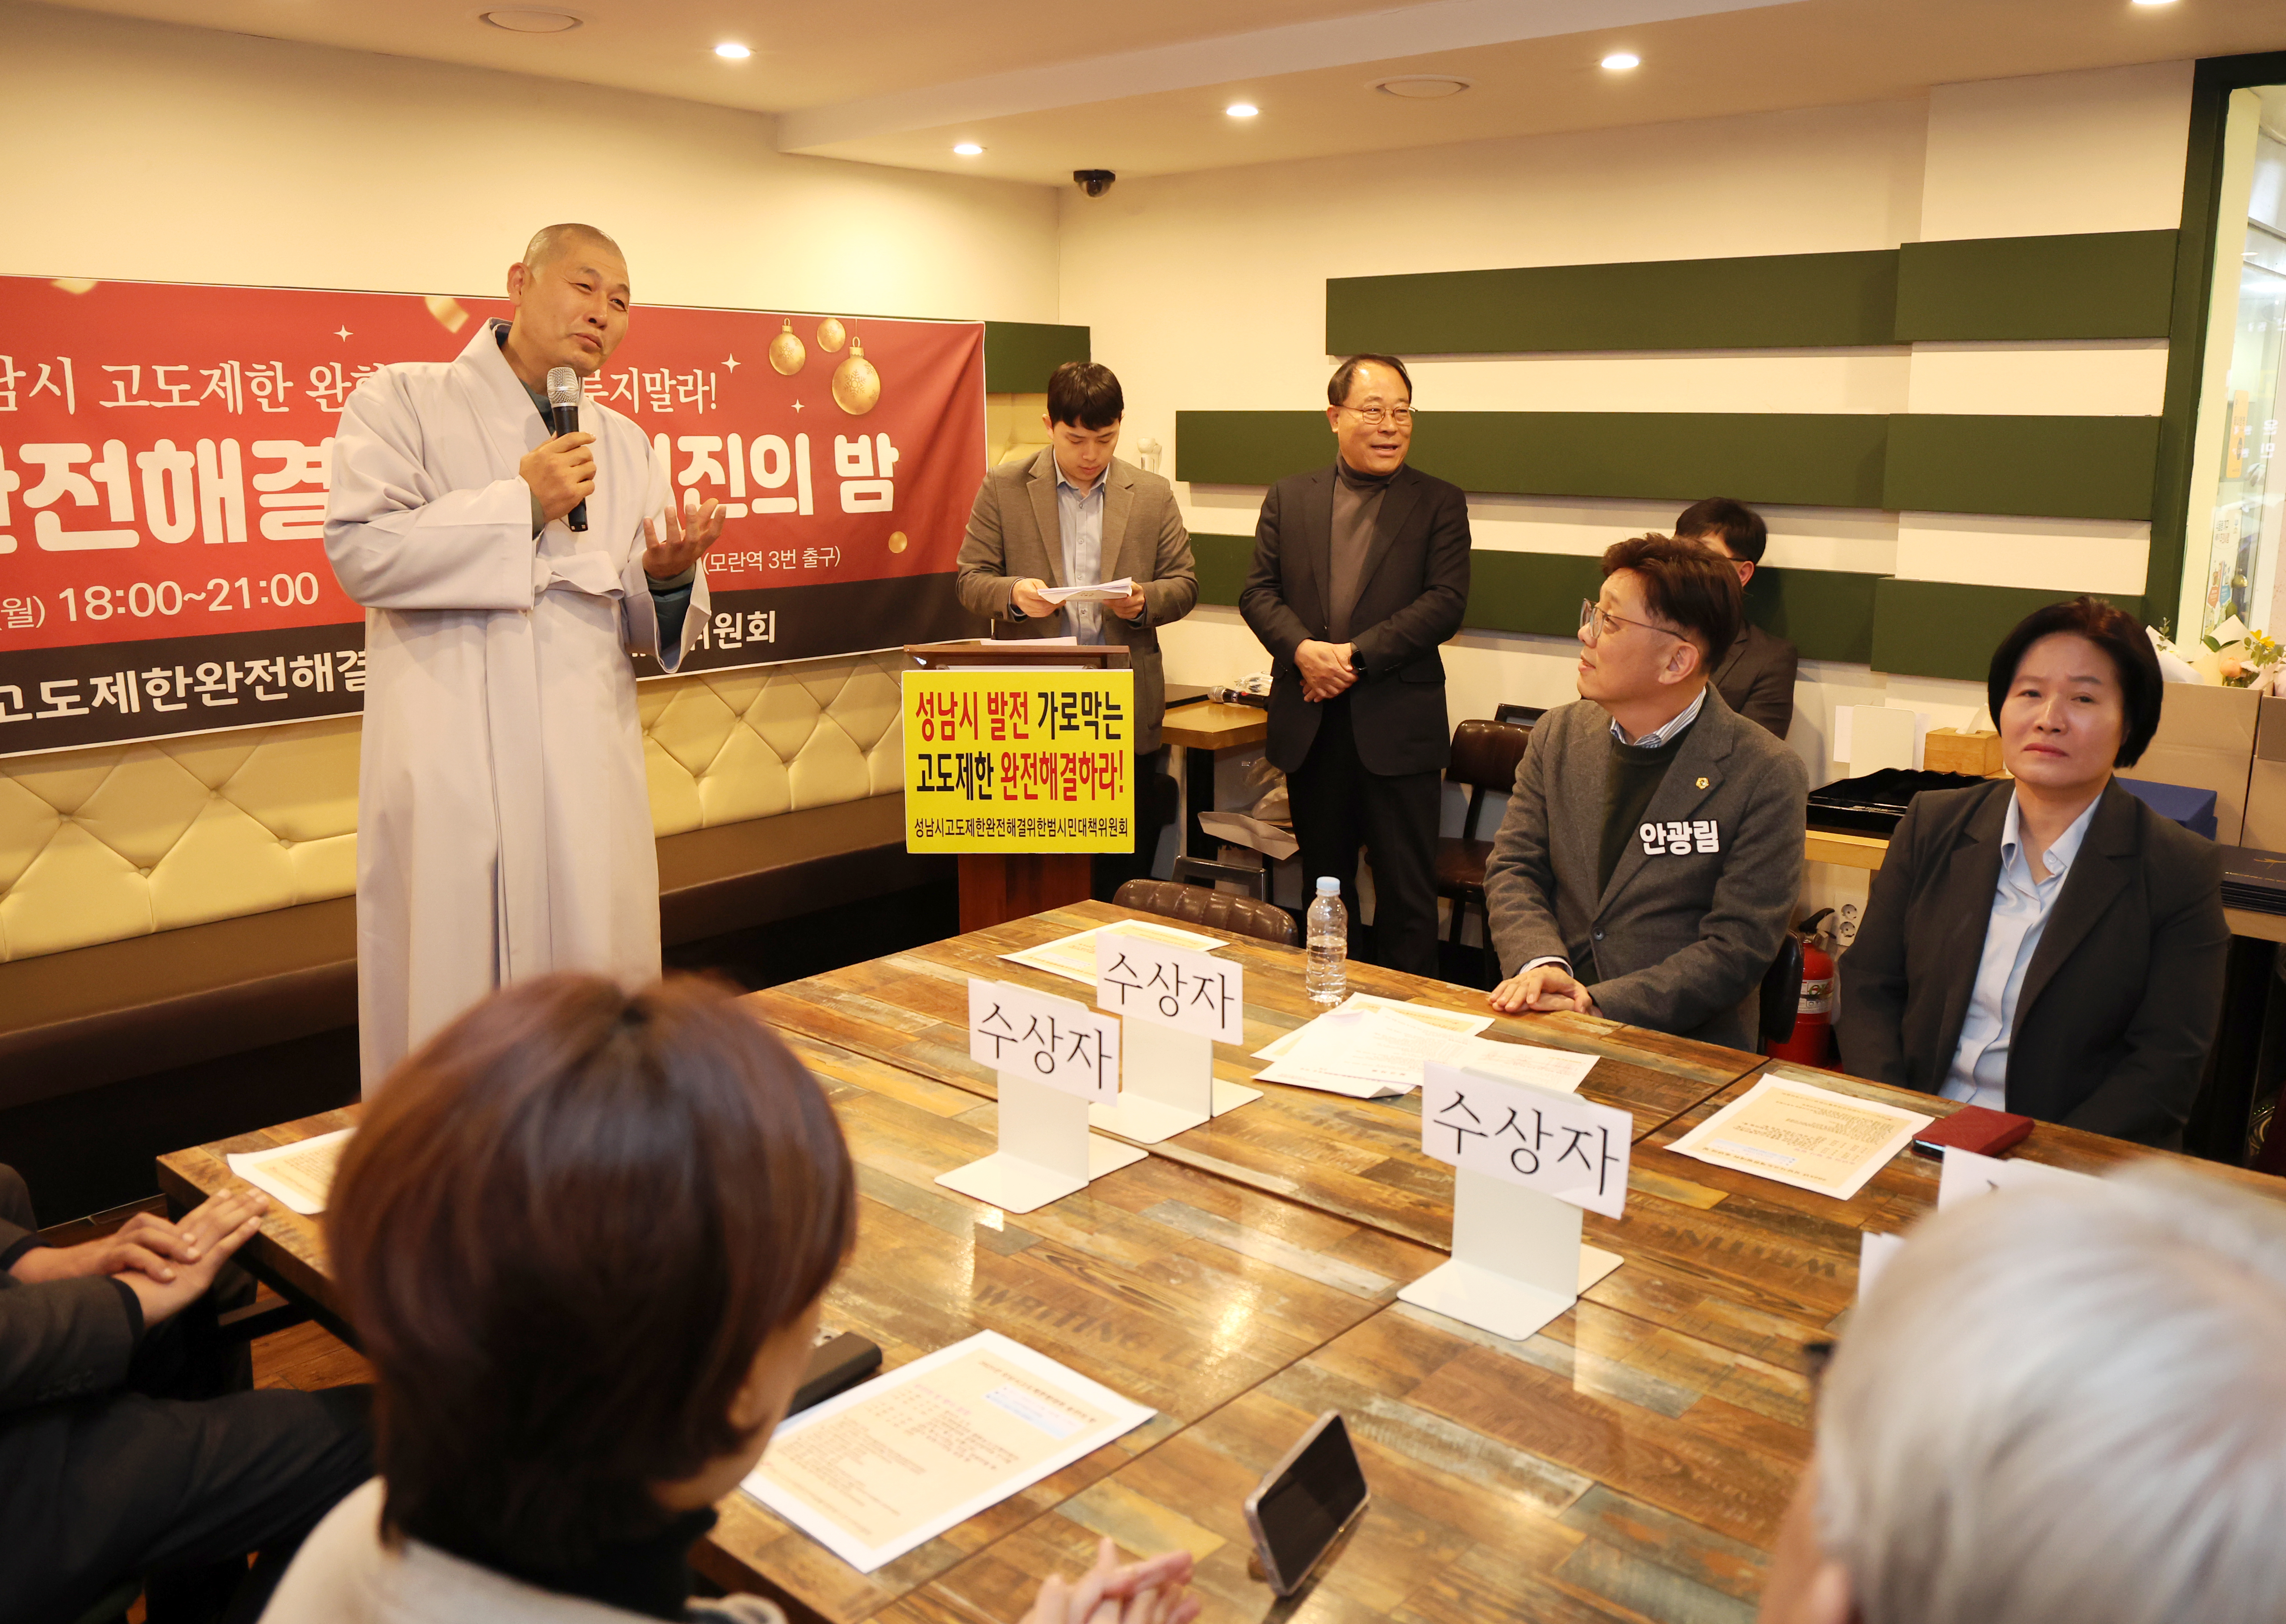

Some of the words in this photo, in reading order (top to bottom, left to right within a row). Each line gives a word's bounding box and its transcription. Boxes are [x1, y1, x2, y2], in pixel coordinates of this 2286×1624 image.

[99, 360, 294, 415] 고도제한
[834, 432, 899, 514] 밤
[59, 572, 318, 621] 18:00~21:00
[703, 551, 762, 575] (모란역
[768, 548, 796, 569] 3번
[802, 545, 840, 568] 출구)
[916, 691, 978, 742] 성남시
[988, 691, 1029, 741] 발전
[1038, 691, 1123, 740] 가로막는
[917, 751, 994, 801] 고도제한
[1001, 750, 1123, 801] 완전해결하라!
[914, 817, 1128, 838] 성남시고도제한완전해결위한범시민대책위원회
[1639, 820, 1720, 855] 안광림
[1104, 952, 1235, 1030] 수상자
[977, 1003, 1112, 1090] 수상자
[1433, 1091, 1620, 1197] 수상자
